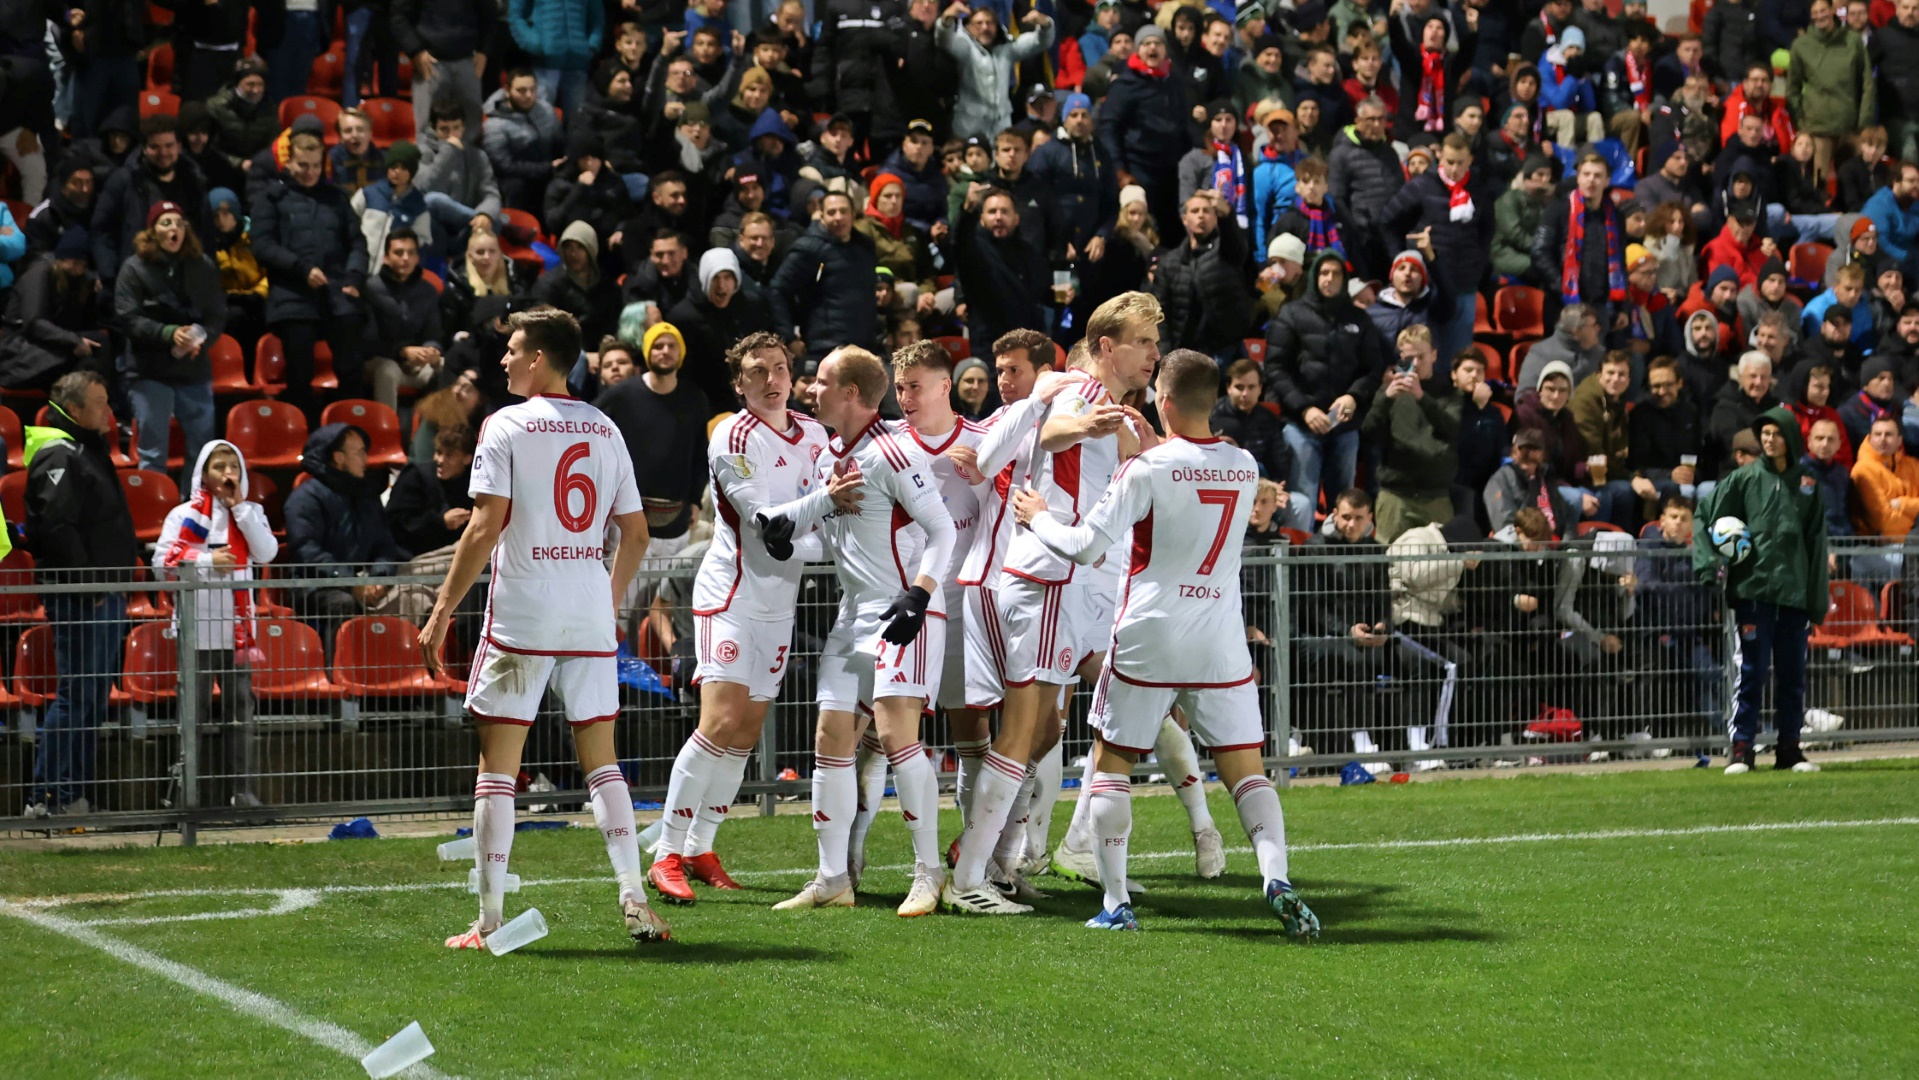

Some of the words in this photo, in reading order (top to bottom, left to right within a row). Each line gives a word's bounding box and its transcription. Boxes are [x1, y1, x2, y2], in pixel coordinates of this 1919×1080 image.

[526, 418, 613, 439] DÜSSELDORF
[912, 473, 925, 488] C
[1172, 467, 1256, 483] DÜSSELDORF
[554, 442, 597, 533] 6
[1196, 489, 1240, 576] 7
[769, 645, 789, 673] 3
[487, 852, 506, 863] F95
